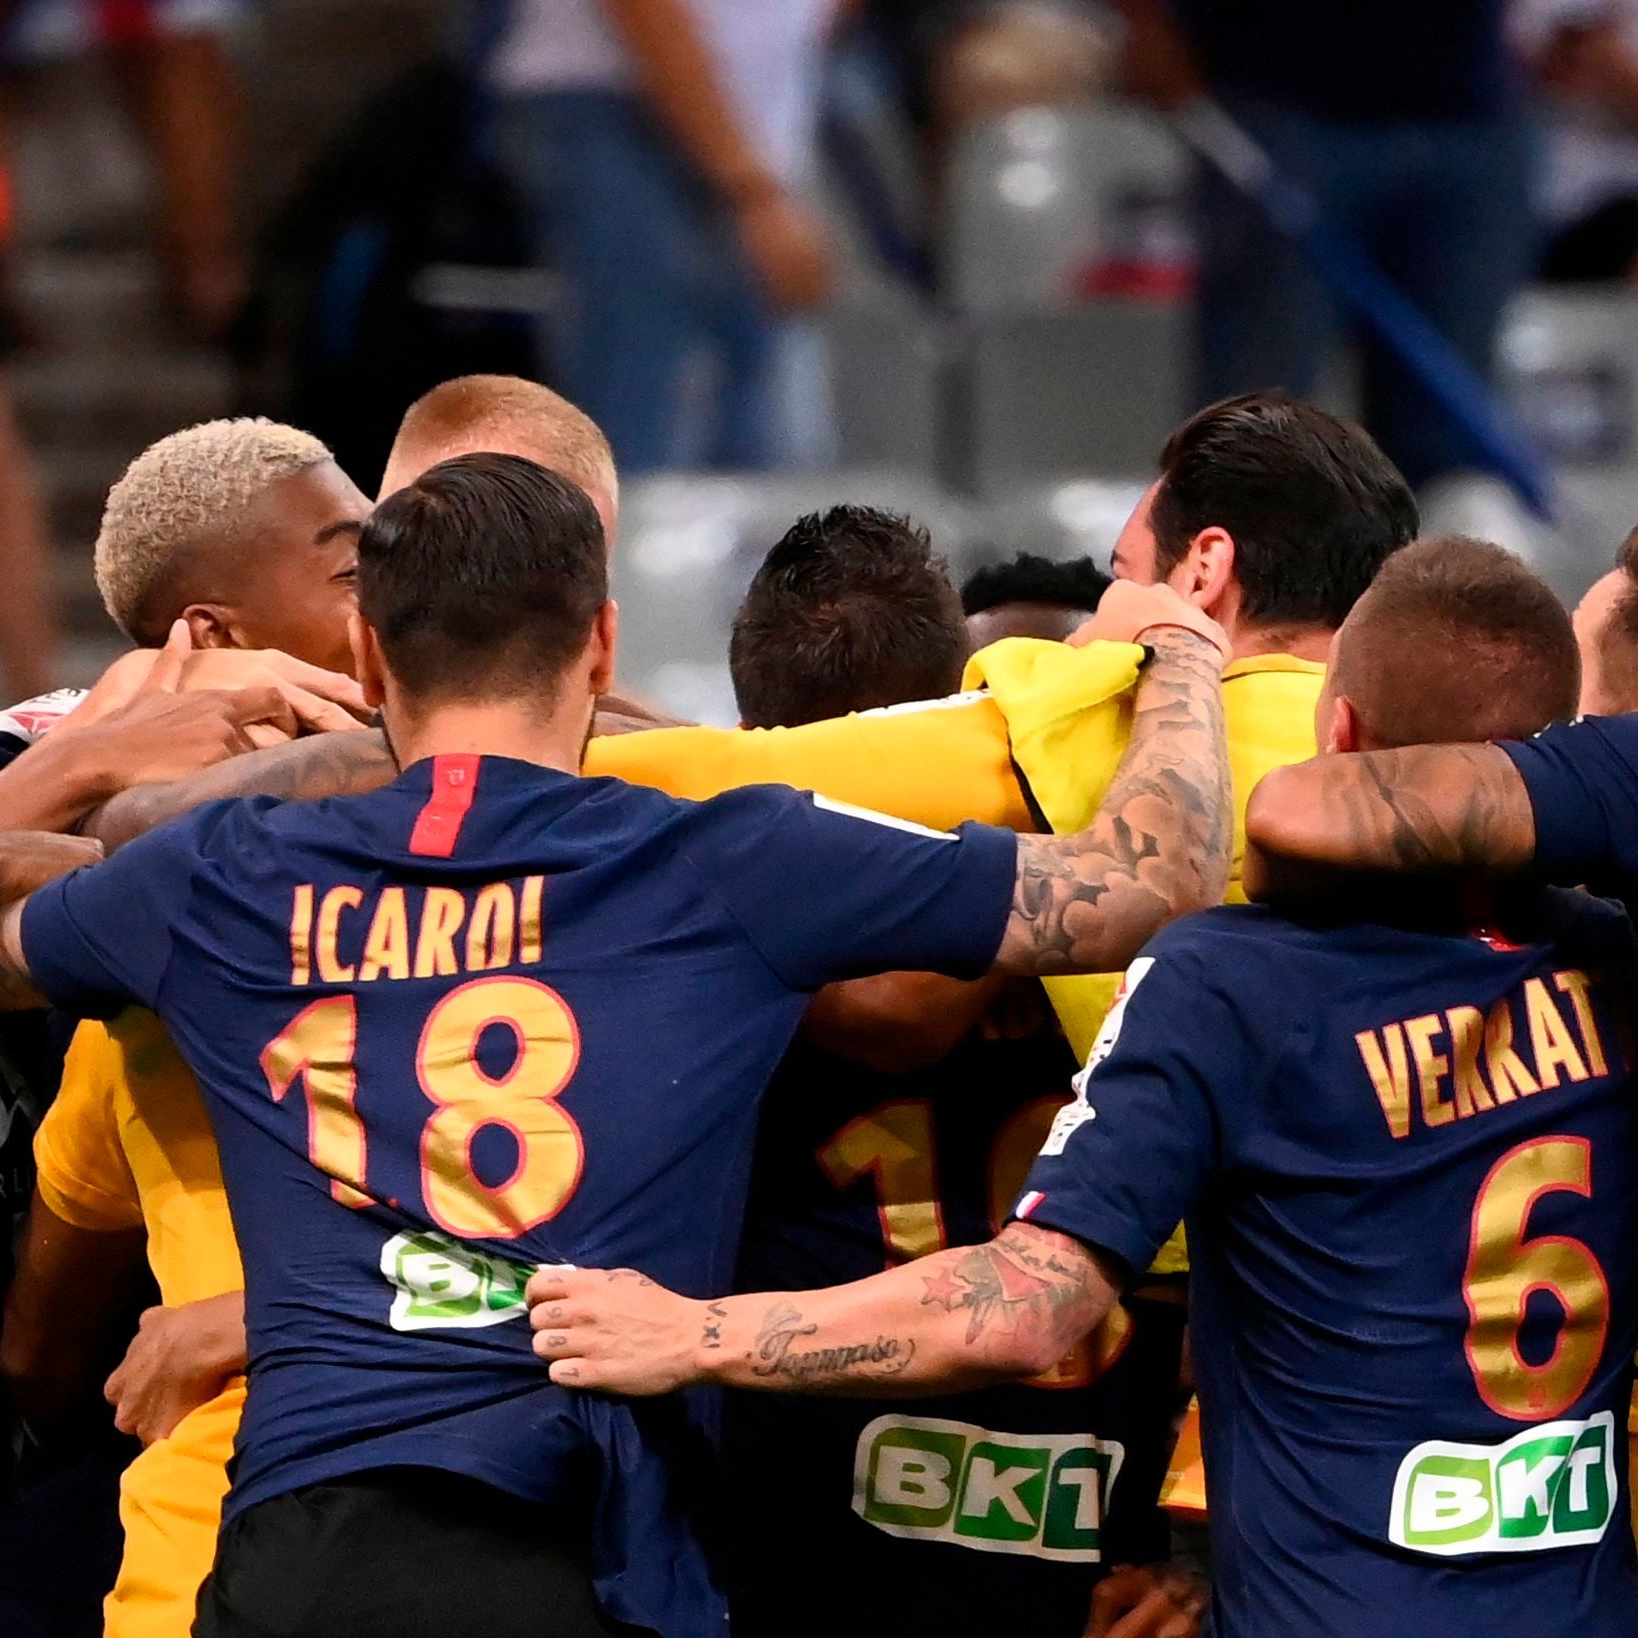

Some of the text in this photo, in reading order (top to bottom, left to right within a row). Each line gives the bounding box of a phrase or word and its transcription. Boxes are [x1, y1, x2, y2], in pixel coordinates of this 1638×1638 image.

[289, 874, 546, 987] ICARDI
[258, 974, 587, 1241] 18
[1353, 968, 1612, 1140] VERRAT
[1462, 1134, 1610, 1422] 6
[869, 1442, 1101, 1531] BKT
[1407, 1444, 1603, 1535] BKT
